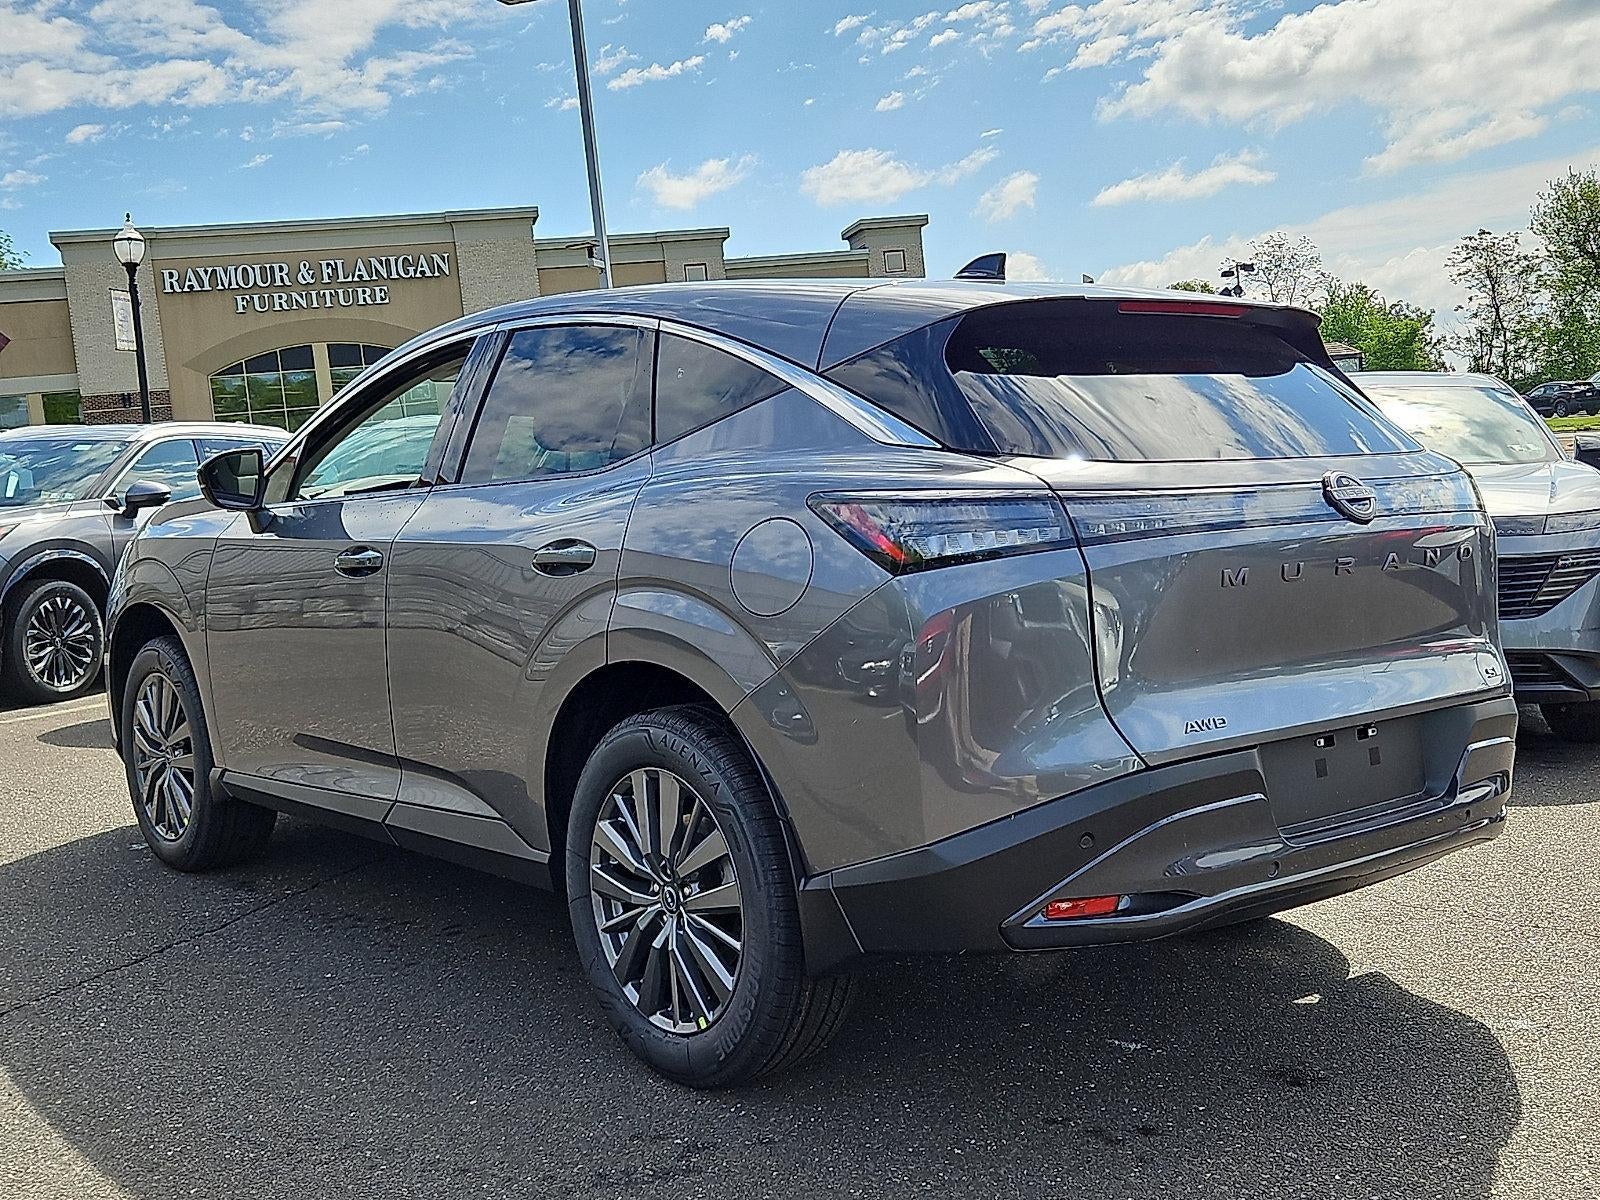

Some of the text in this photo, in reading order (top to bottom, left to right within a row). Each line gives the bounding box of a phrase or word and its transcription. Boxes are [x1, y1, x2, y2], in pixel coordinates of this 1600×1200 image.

[161, 253, 451, 293] RAYMOUR & FLANIGAN
[233, 286, 391, 314] FURNITURE
[1220, 542, 1474, 588] MURANO
[1184, 716, 1228, 735] AWD
[658, 733, 722, 797] ALENZA
